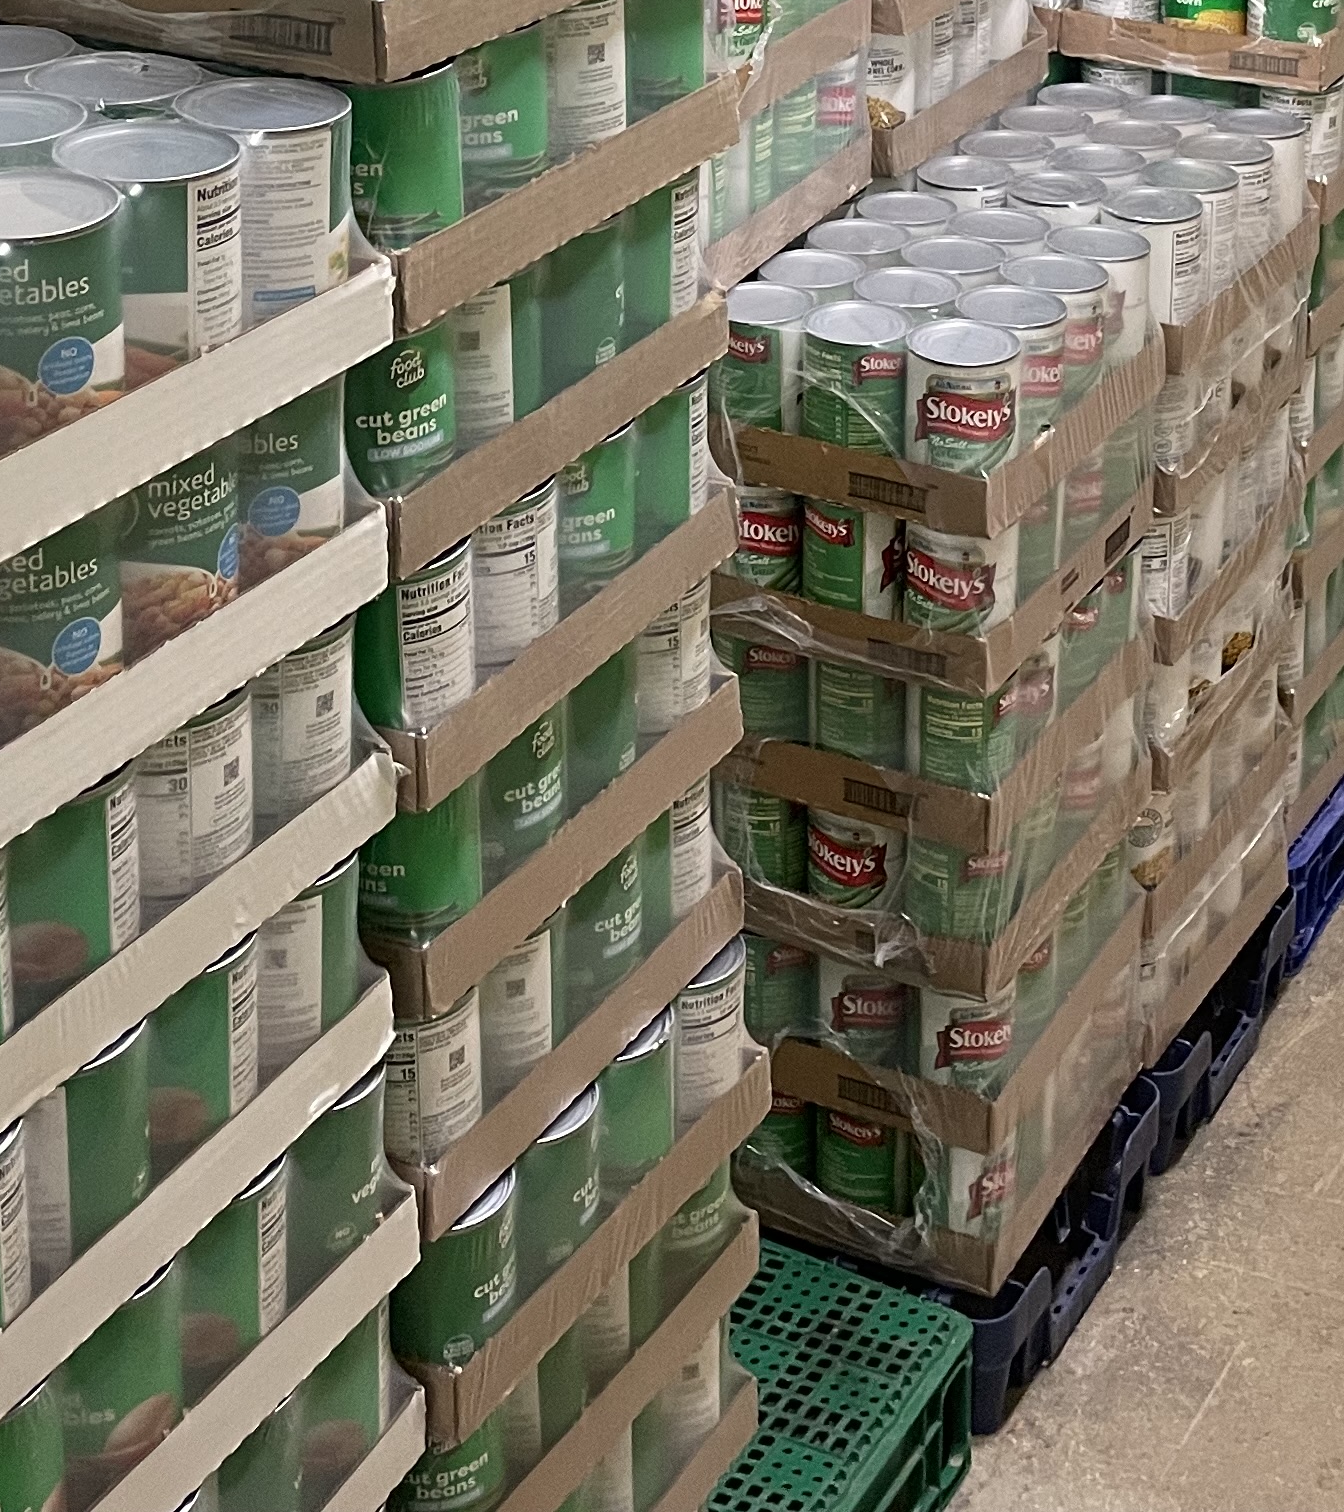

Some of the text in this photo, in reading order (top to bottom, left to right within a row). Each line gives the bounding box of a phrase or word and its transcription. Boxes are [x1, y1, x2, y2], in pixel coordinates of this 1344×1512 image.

[61, 347, 77, 358] NO
[390, 356, 422, 380] food
[396, 366, 425, 389] club
[356, 393, 447, 430] cut green
[926, 395, 1011, 429] Stokely's
[377, 418, 437, 446] beans
[148, 462, 215, 498] mixed
[505, 513, 535, 530] Facts
[523, 551, 536, 564] 15
[401, 577, 451, 601] Nutrition
[402, 623, 442, 643] Calories
[666, 636, 679, 650] 15
[168, 777, 188, 792] 30
[504, 782, 536, 803] cut
[595, 912, 622, 932] cut
[842, 994, 898, 1015] Stoke
[949, 1025, 1012, 1048] Stokel
[401, 1067, 416, 1080] 15
[573, 1177, 595, 1204] cut
[474, 1284, 505, 1299] cut
[436, 1452, 488, 1487] green
[416, 1476, 477, 1500] beans
